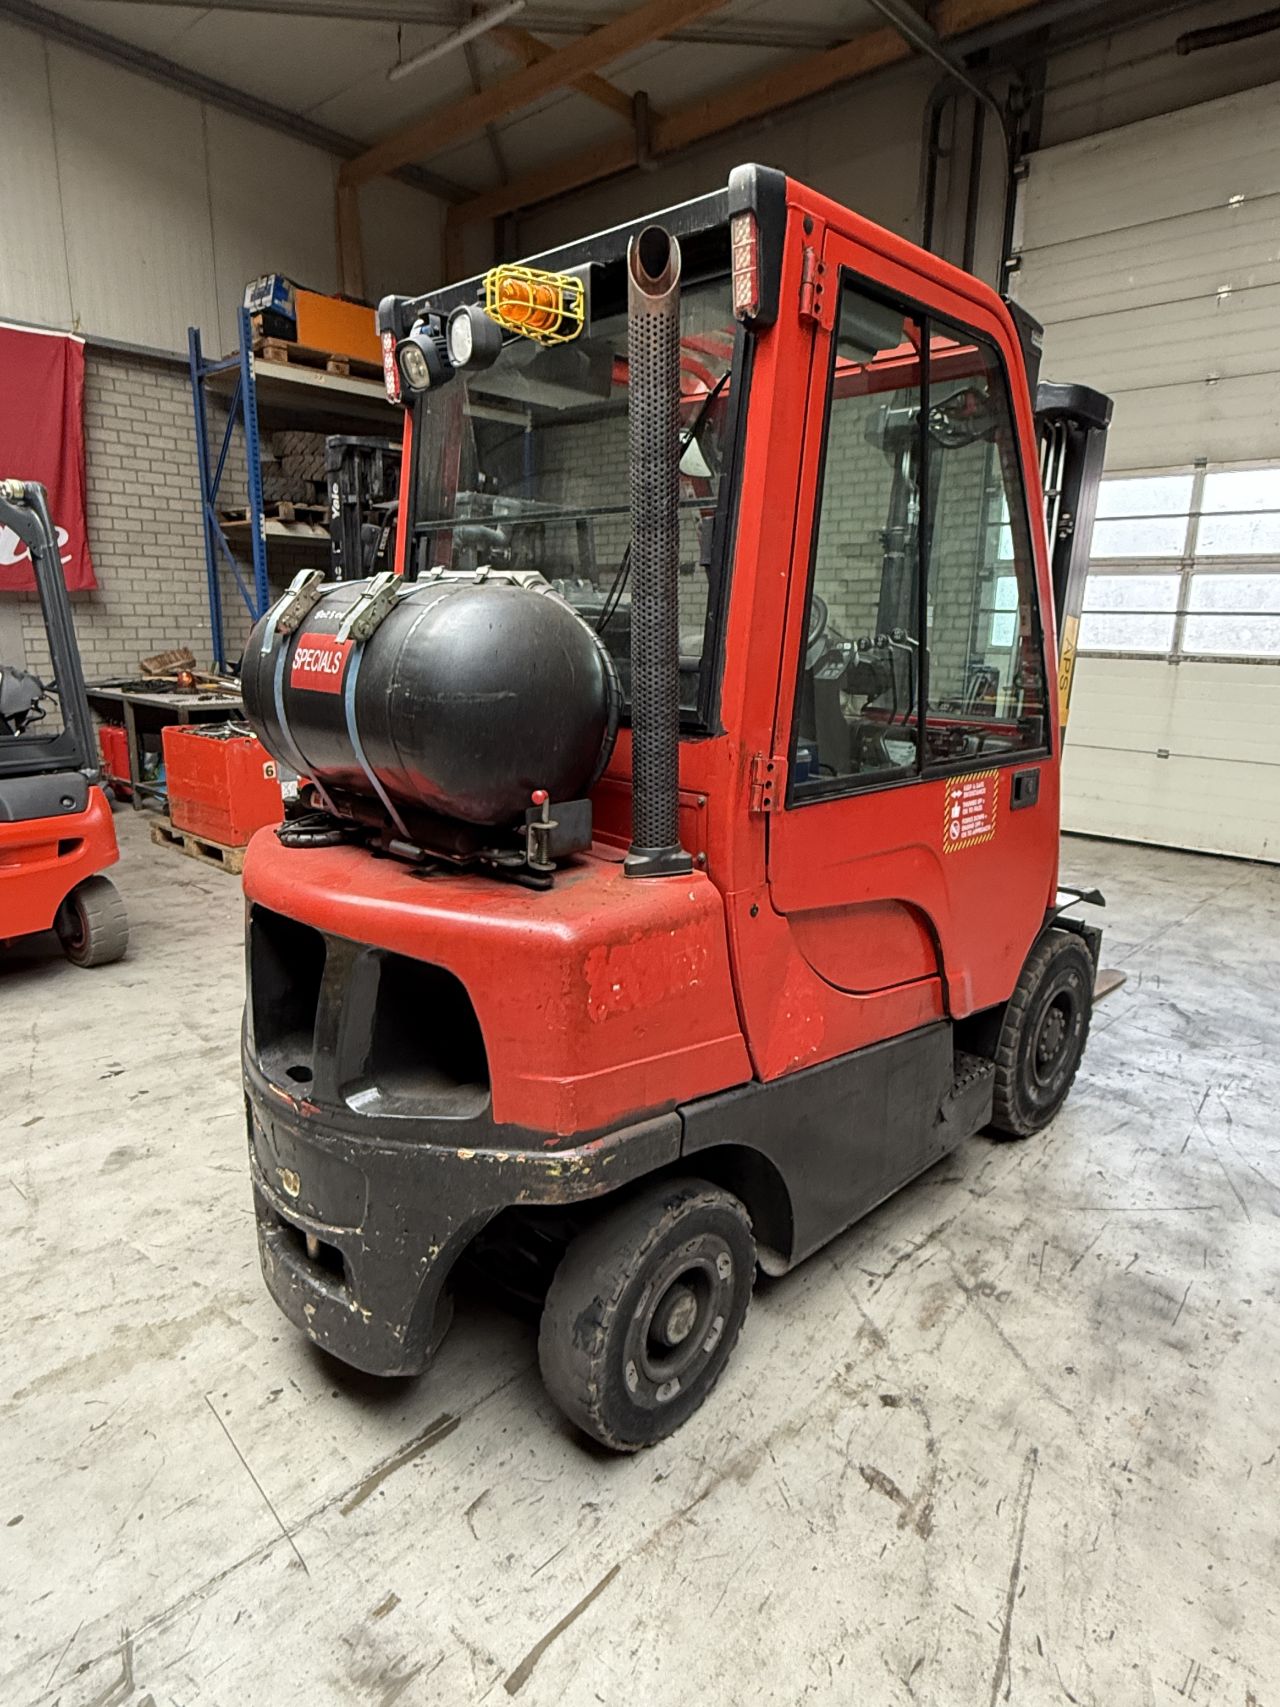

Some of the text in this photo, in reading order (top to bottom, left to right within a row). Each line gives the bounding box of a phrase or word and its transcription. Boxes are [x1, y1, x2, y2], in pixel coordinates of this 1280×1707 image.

[331, 482, 341, 519] Yale
[292, 648, 342, 674] SPECIALS
[265, 764, 274, 777] 6
